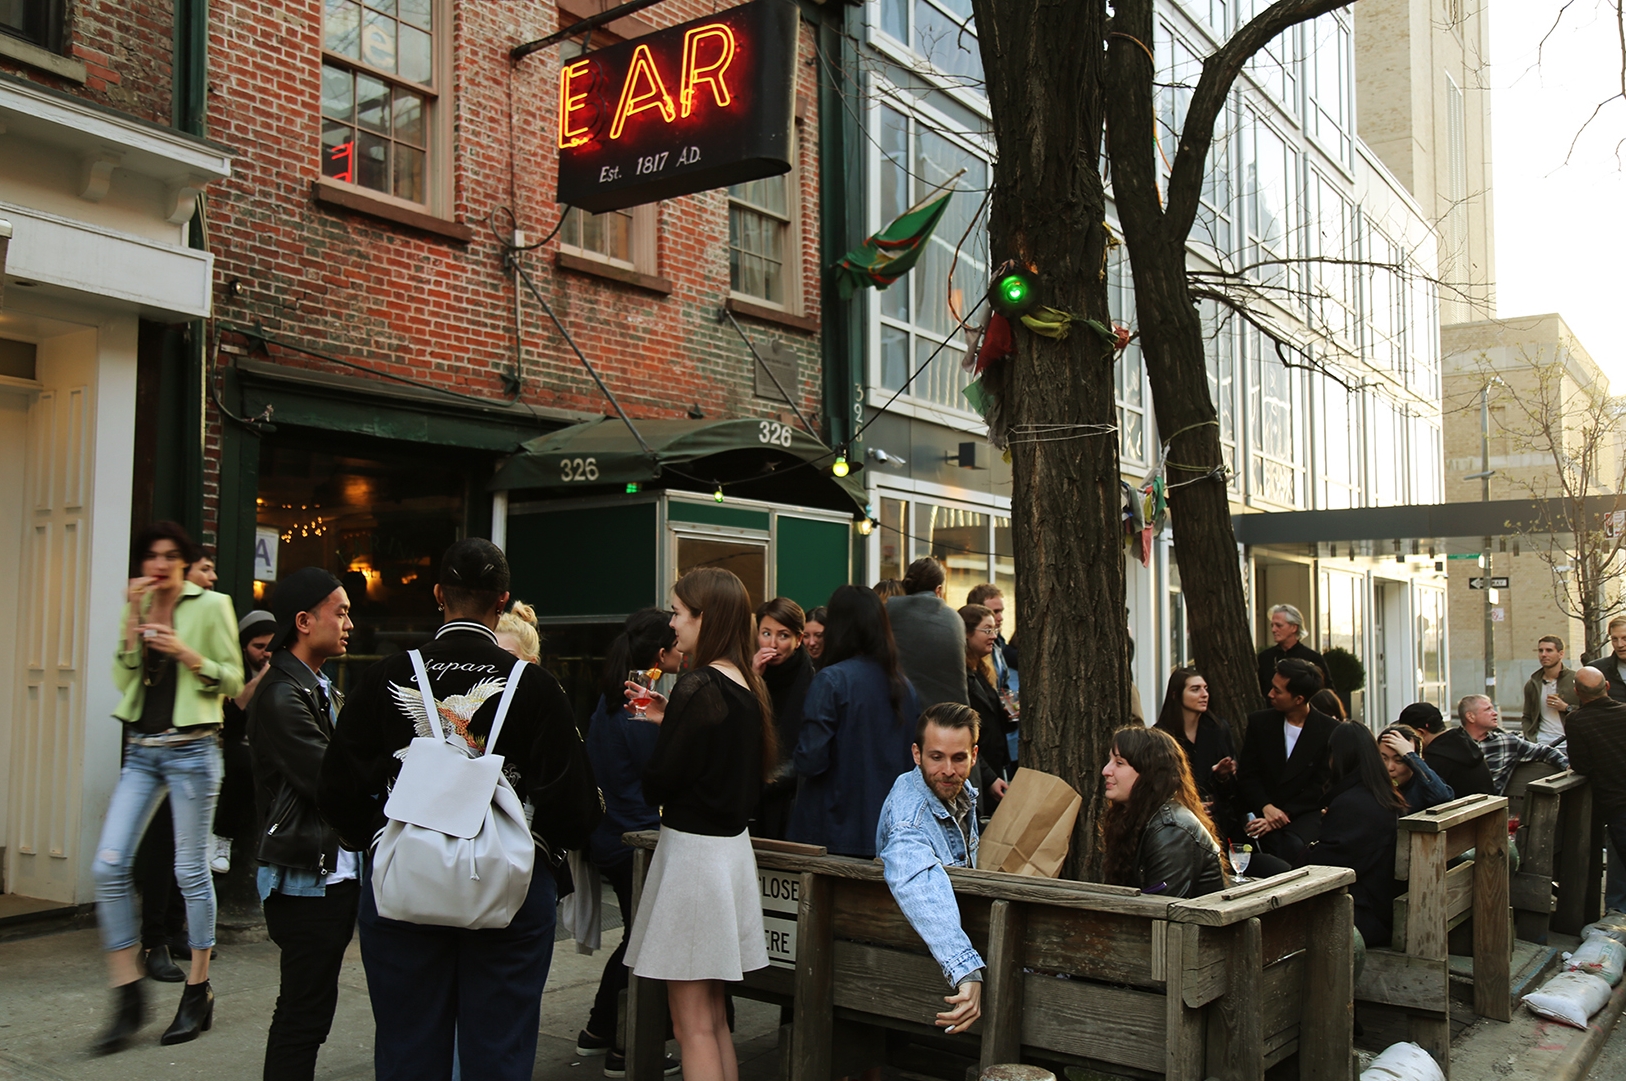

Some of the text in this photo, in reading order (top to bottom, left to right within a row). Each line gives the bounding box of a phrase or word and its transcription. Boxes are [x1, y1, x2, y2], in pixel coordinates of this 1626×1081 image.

[559, 24, 735, 148] EAR
[599, 166, 622, 183] Est.
[636, 152, 669, 175] 1817
[854, 383, 865, 443] 326
[758, 421, 793, 447] 326
[559, 457, 600, 482] 326
[255, 538, 271, 567] A
[759, 876, 800, 901] LOSE
